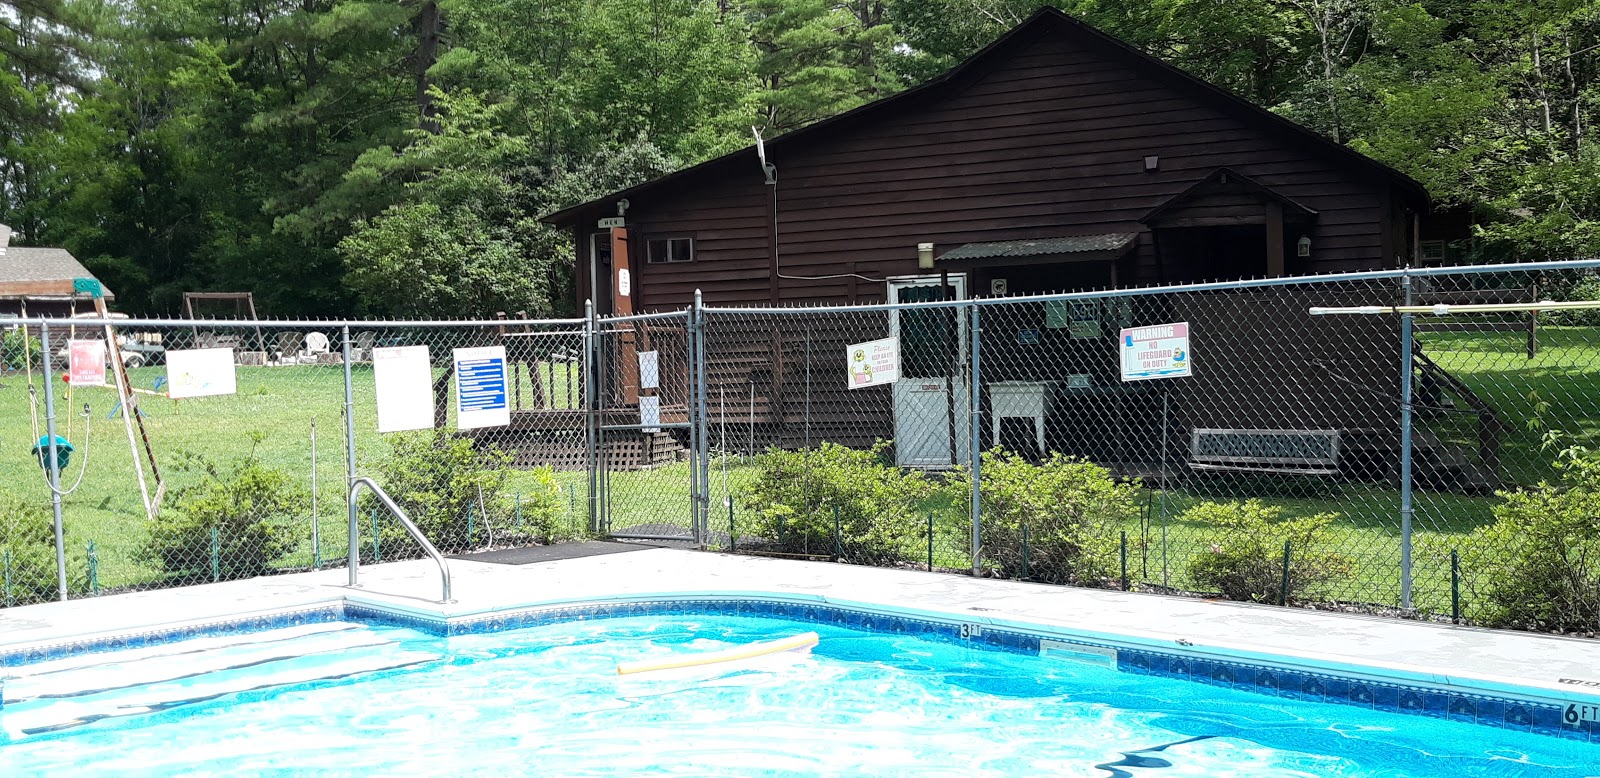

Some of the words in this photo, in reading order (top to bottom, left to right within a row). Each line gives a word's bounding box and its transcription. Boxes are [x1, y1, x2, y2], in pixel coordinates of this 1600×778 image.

[1132, 326, 1174, 340] WARNING
[1149, 341, 1158, 350] NO
[1137, 350, 1172, 360] LIFEGUARD
[872, 364, 895, 373] CHILDREN
[961, 624, 970, 638] 3
[970, 625, 982, 636] FT
[1564, 703, 1579, 723] 6
[1581, 705, 1599, 721] FT
